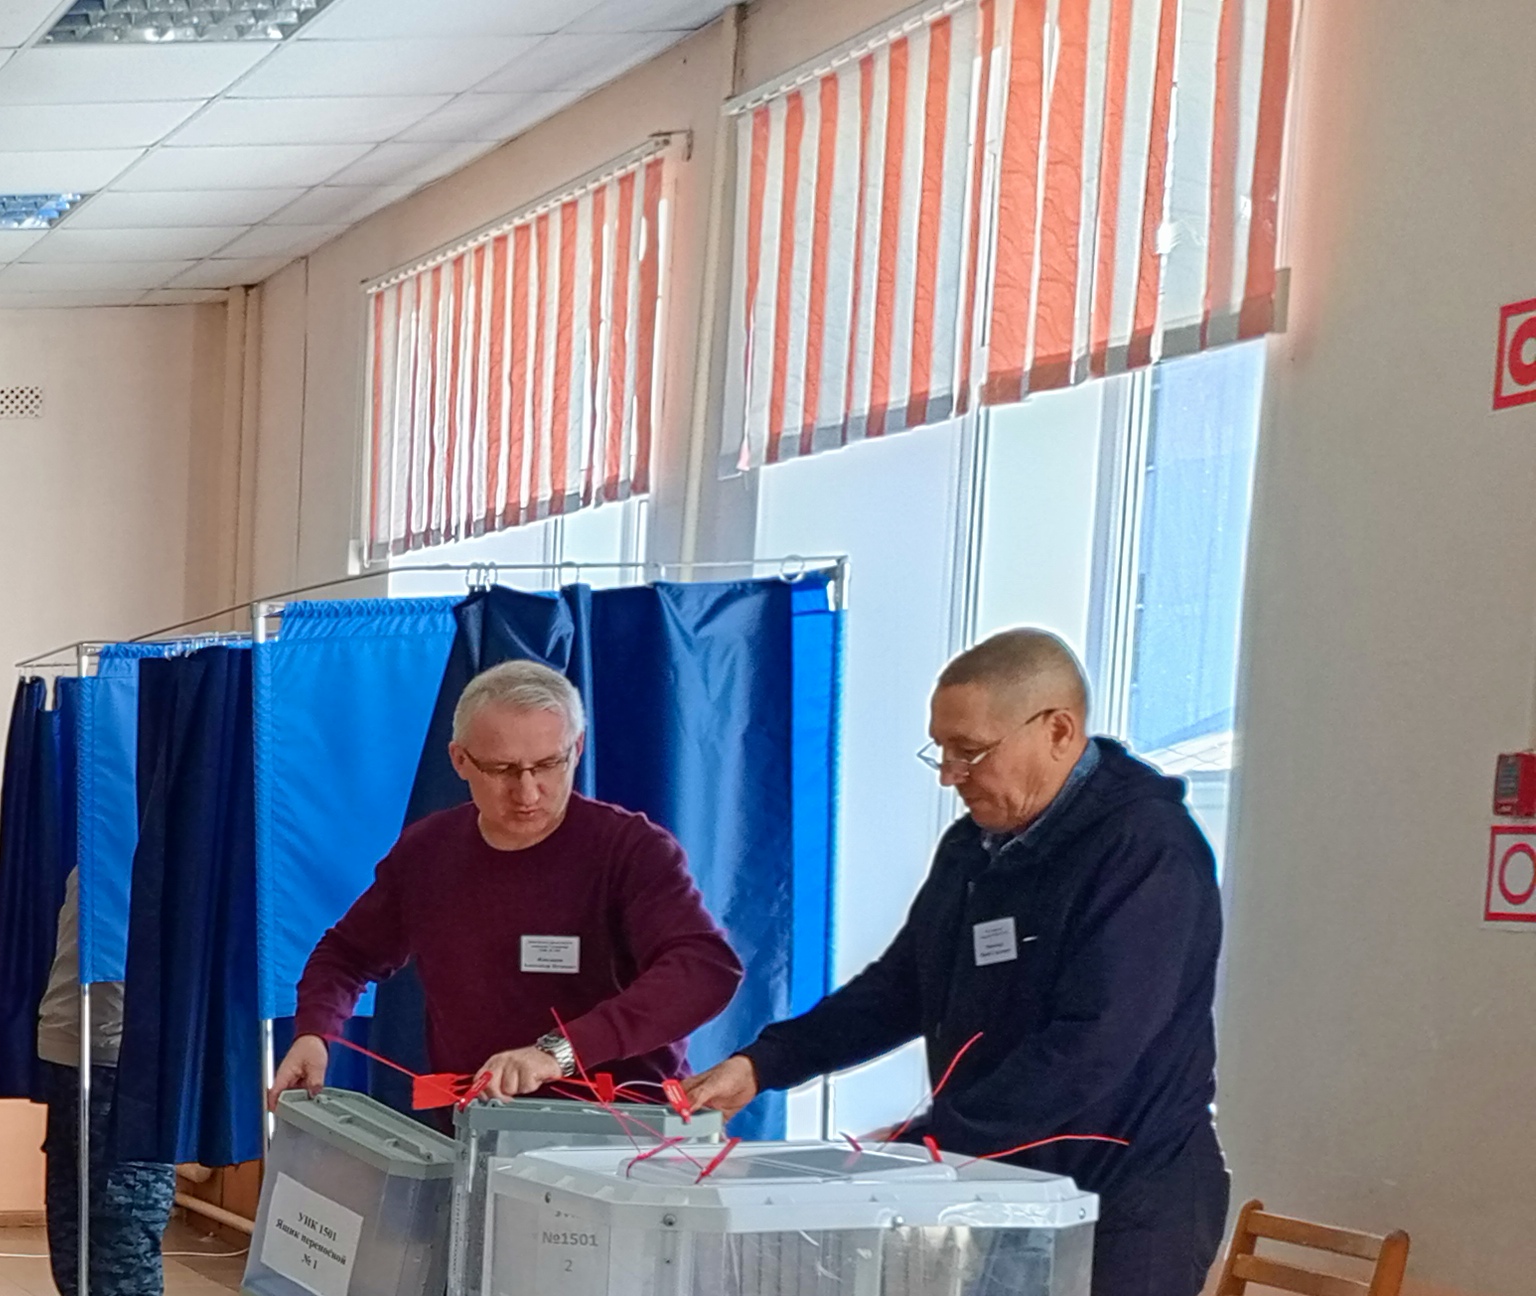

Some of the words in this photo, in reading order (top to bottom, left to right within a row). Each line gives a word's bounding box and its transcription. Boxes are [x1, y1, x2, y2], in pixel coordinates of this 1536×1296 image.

[275, 1218, 300, 1240] Ящик
[297, 1211, 319, 1231] УИК
[319, 1224, 338, 1242] 1501
[542, 1231, 599, 1247] №1501
[312, 1259, 318, 1270] 1
[564, 1259, 573, 1272] 2
